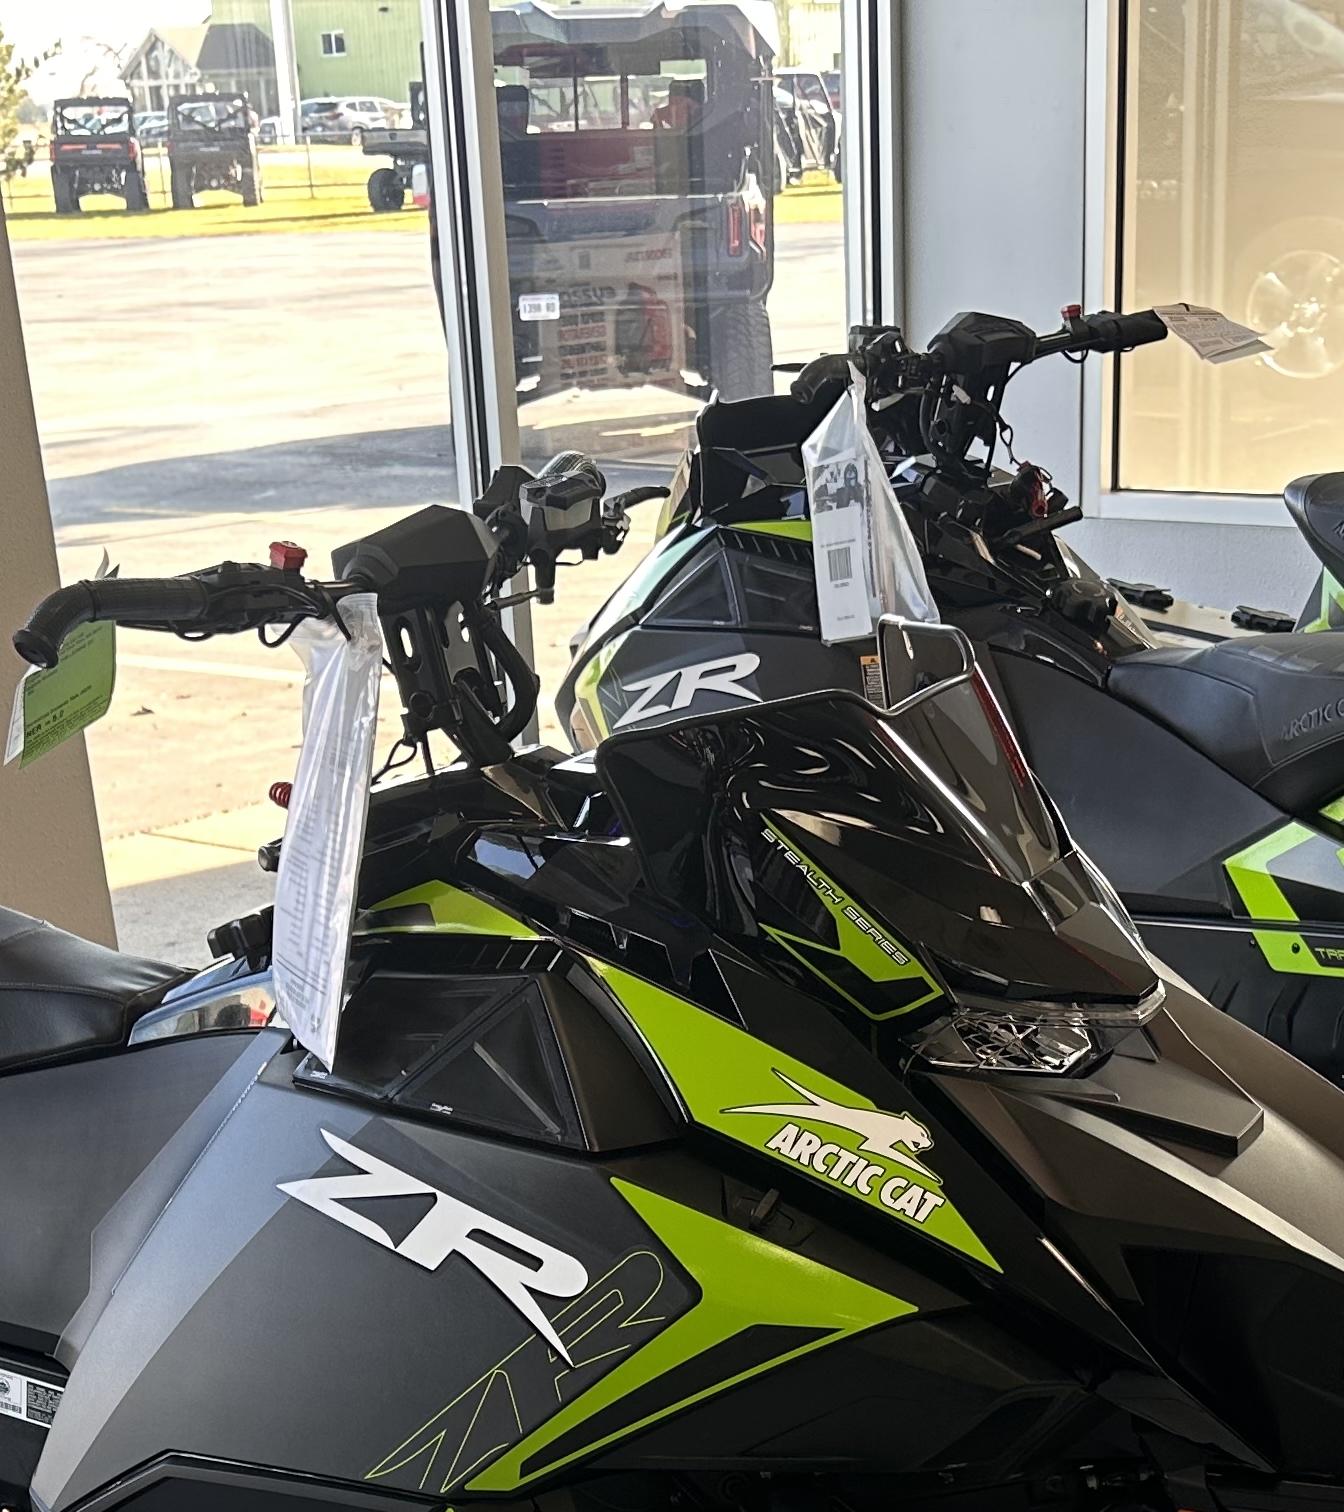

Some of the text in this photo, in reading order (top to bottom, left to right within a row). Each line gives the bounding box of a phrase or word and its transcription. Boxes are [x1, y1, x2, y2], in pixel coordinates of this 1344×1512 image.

[613, 653, 764, 729] ZR
[1279, 703, 1332, 741] ARCTIC
[761, 828, 910, 966] STEALTH SERIES
[764, 1122, 946, 1224] ARCTIC CAT
[276, 1127, 589, 1368] ZR
